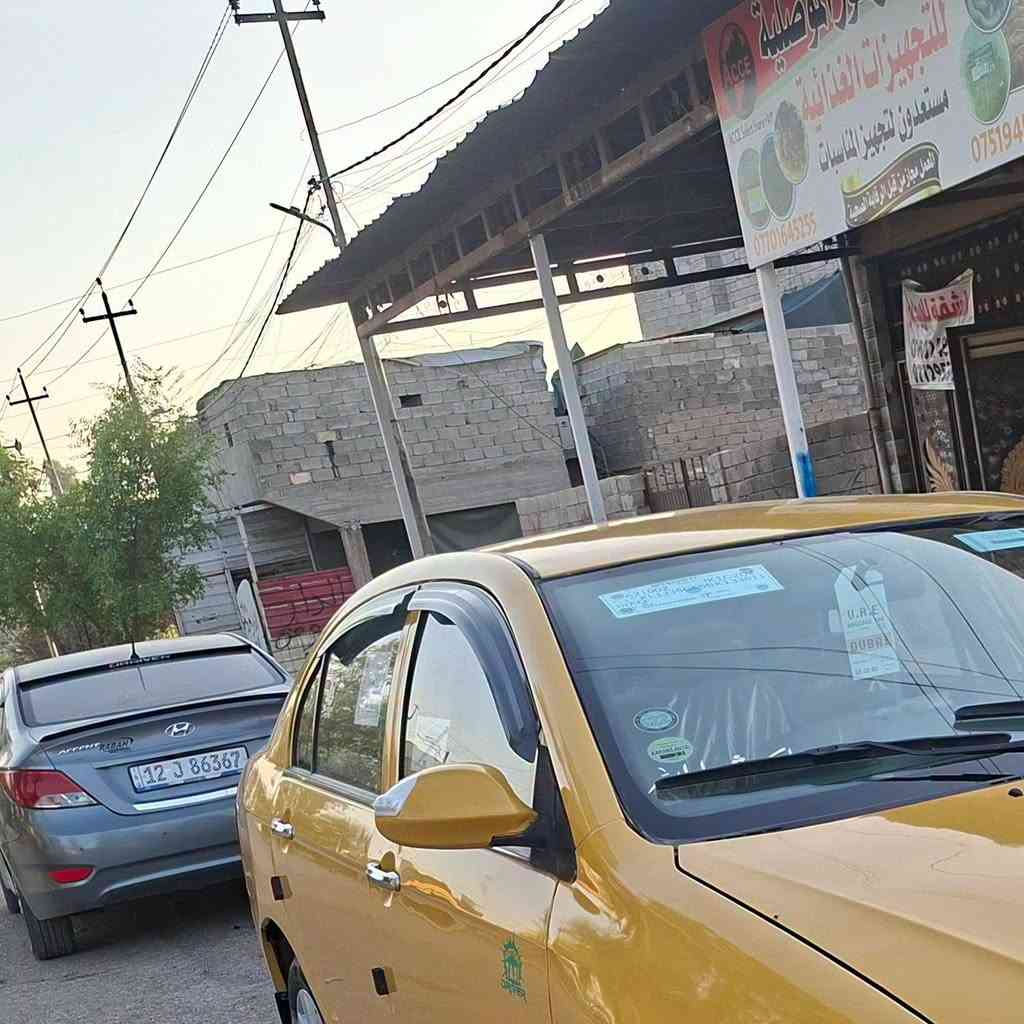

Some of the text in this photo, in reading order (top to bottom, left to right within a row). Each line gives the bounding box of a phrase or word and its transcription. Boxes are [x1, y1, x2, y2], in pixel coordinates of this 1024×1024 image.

[817, 87, 949, 174] مستعدون لتجهيز المناسبات
[143, 765, 167, 784] 12
[174, 764, 184, 778] J
[190, 751, 241, 775] 86367
